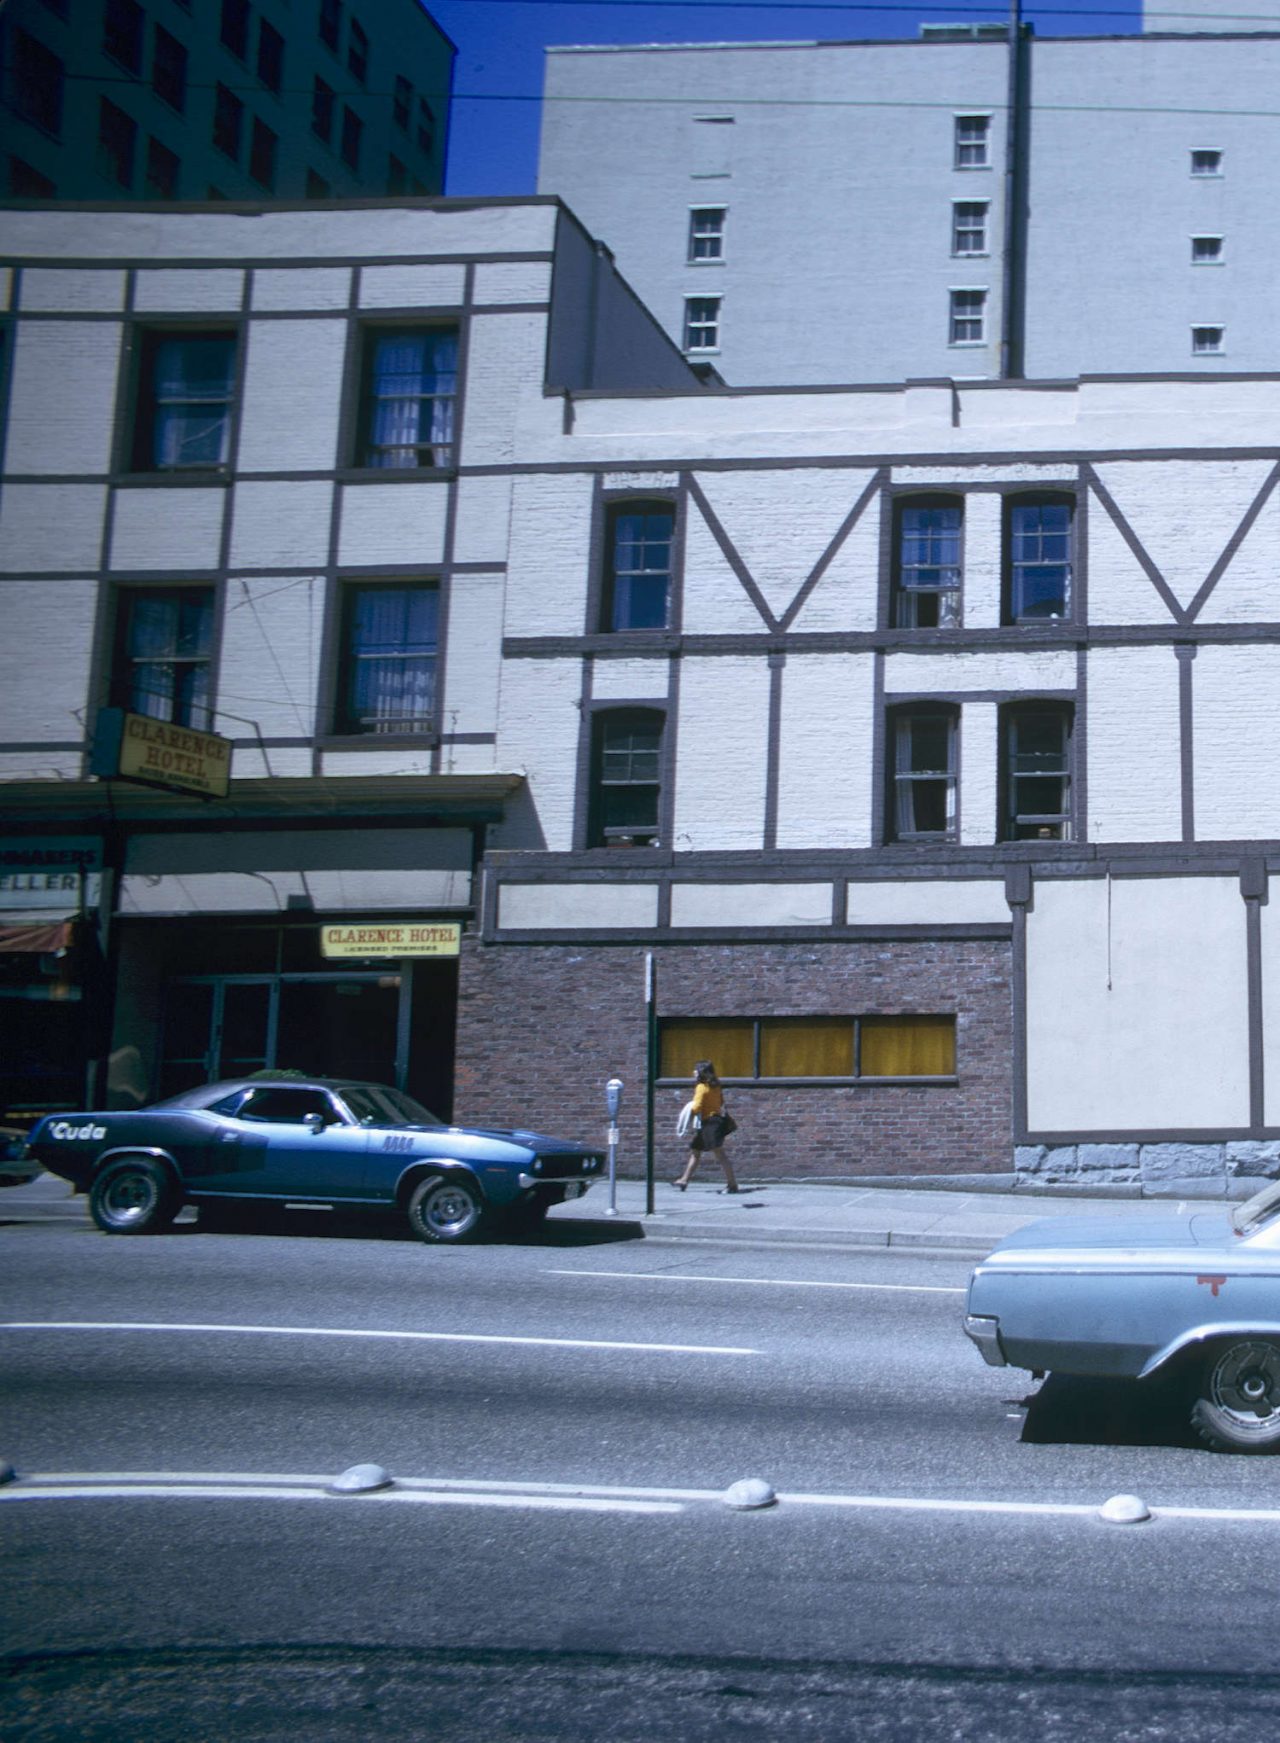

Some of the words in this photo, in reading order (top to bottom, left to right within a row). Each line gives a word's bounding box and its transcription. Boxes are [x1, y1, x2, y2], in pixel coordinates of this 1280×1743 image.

[129, 719, 227, 761] CLARENCE
[145, 744, 208, 778] HOTEL
[328, 928, 404, 944] CLARENCE
[410, 927, 457, 943] HOTEL
